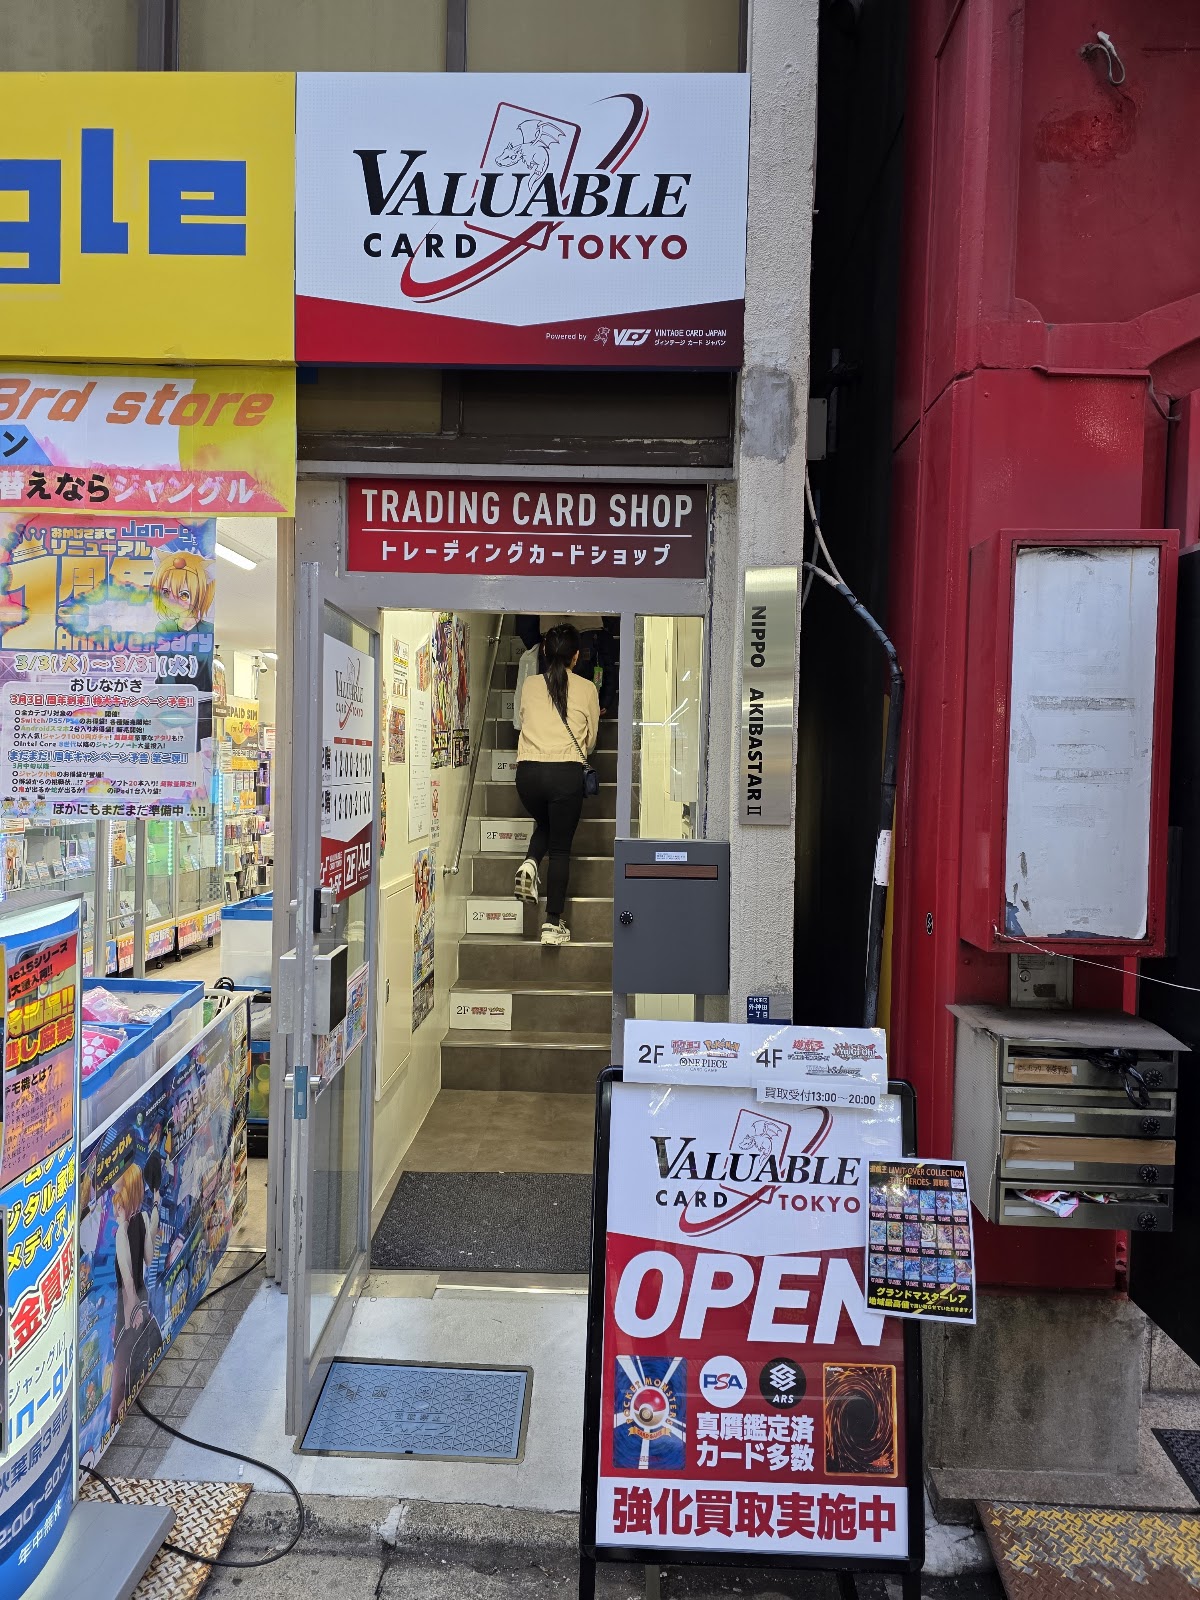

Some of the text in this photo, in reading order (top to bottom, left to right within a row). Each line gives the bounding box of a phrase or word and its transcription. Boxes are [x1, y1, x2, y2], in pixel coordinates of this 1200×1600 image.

[353, 149, 691, 217] VALUABLE
[363, 232, 688, 260] CARD TOKYO
[545, 332, 588, 342] Powered by
[654, 329, 727, 337] VINTAGE CARD JAPAN
[106, 383, 275, 426] store
[361, 489, 693, 528] TRADING CARD SHOP
[51, 539, 152, 557] リニューアル
[382, 540, 672, 567] トレーディングカードショップ
[750, 605, 767, 668] NIPPO
[70, 680, 143, 693] おしながき
[11, 694, 43, 706] 3月3日
[747, 688, 764, 801] AKIBASTAR
[8, 750, 51, 763] まだまだ!
[497, 762, 508, 770] 2F
[52, 803, 184, 817] ほかにもまだまだ準備中
[486, 832, 498, 840] 2F
[472, 912, 485, 921] 2F
[456, 1005, 470, 1015] 2F
[748, 1003, 769, 1011] 外神田
[748, 1011, 769, 1019] 一丁目
[638, 1043, 664, 1064] 2F
[756, 1048, 783, 1069] 4F
[680, 1057, 728, 1069] ONE PIECE
[650, 1135, 861, 1187] VALUABLE
[926, 1168, 965, 1179] COLLECTION
[656, 1189, 861, 1214] CARD TOKYO
[614, 1250, 886, 1347] OPEN
[703, 1373, 745, 1391] PSA
[772, 1394, 794, 1404] ARS
[697, 1411, 815, 1443] 真贋鑑定済
[697, 1440, 815, 1472] カード多数
[612, 1485, 897, 1543] 強化買取実施中
[18, 1499, 62, 1567] 年中無休
